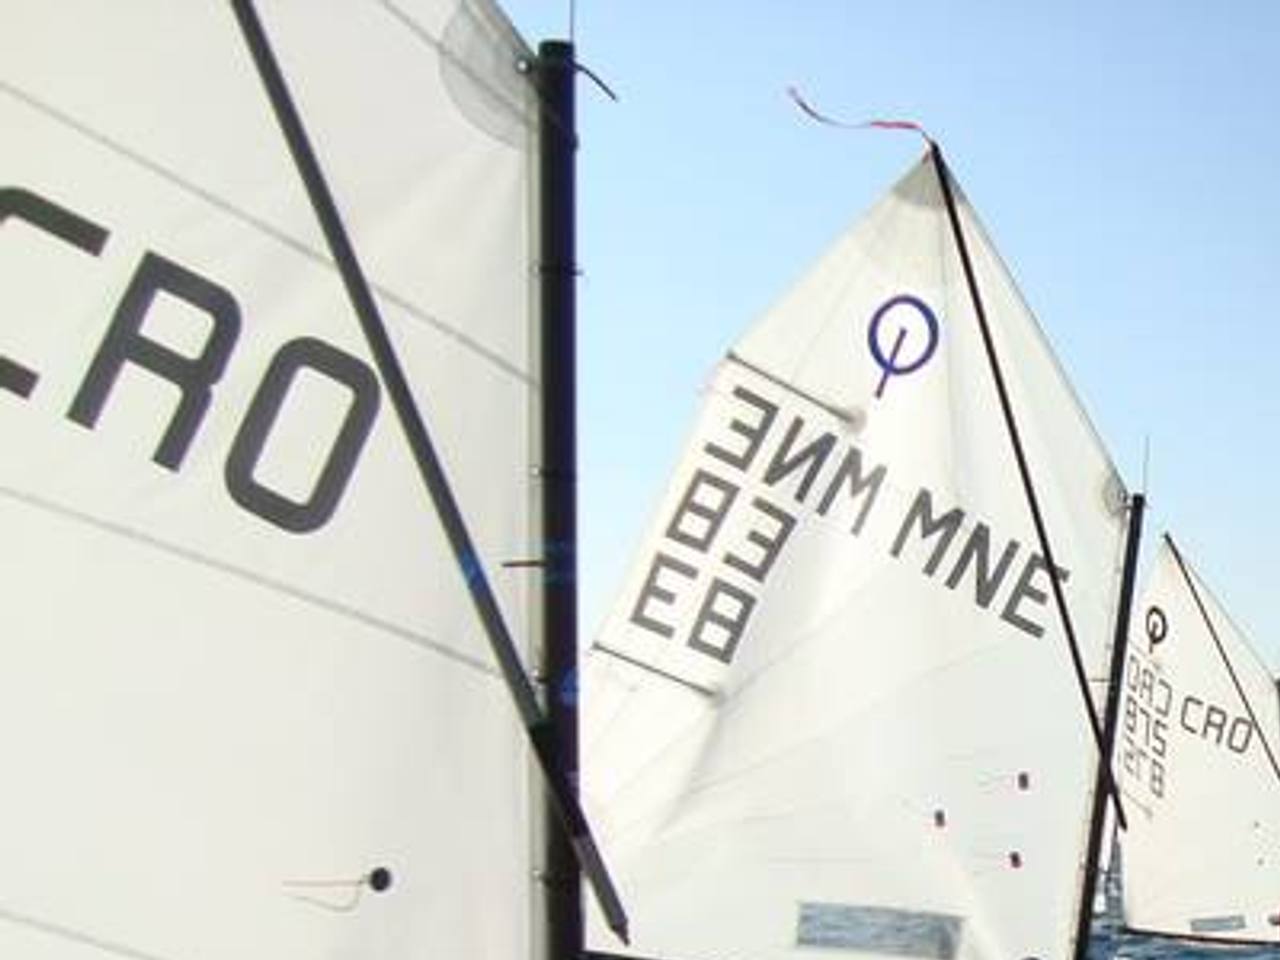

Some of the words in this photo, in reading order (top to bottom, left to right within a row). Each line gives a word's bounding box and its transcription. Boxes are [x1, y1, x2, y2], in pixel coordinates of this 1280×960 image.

[0, 187, 381, 535] CRO
[665, 468, 797, 583] 83
[890, 488, 1070, 638] MNE
[1180, 695, 1252, 754] CRO
